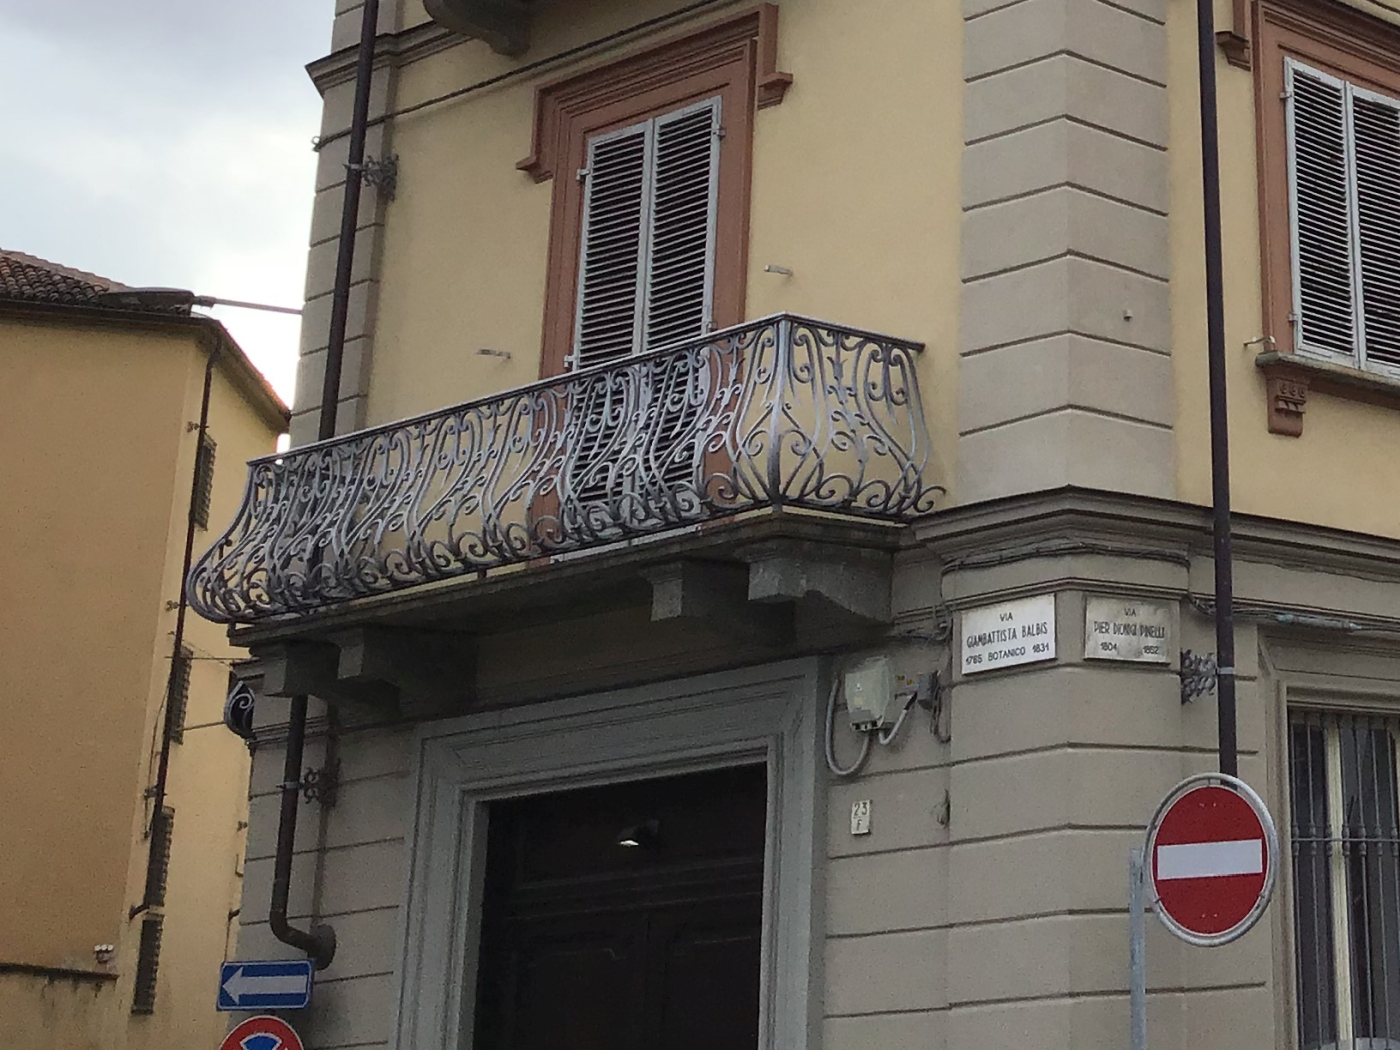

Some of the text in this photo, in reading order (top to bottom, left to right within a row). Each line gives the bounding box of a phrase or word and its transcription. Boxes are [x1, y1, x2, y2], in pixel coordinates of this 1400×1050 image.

[1000, 612, 1013, 622] VIA
[1124, 608, 1137, 617] VIA
[1093, 620, 1110, 634] PIER
[966, 621, 1048, 648] GIAMBATTISTA BALBIS
[987, 646, 1026, 662] BOTANICO
[1032, 642, 1050, 653] 1831
[1100, 641, 1117, 652] 1804
[853, 801, 868, 816] 23
[856, 818, 863, 831] F
